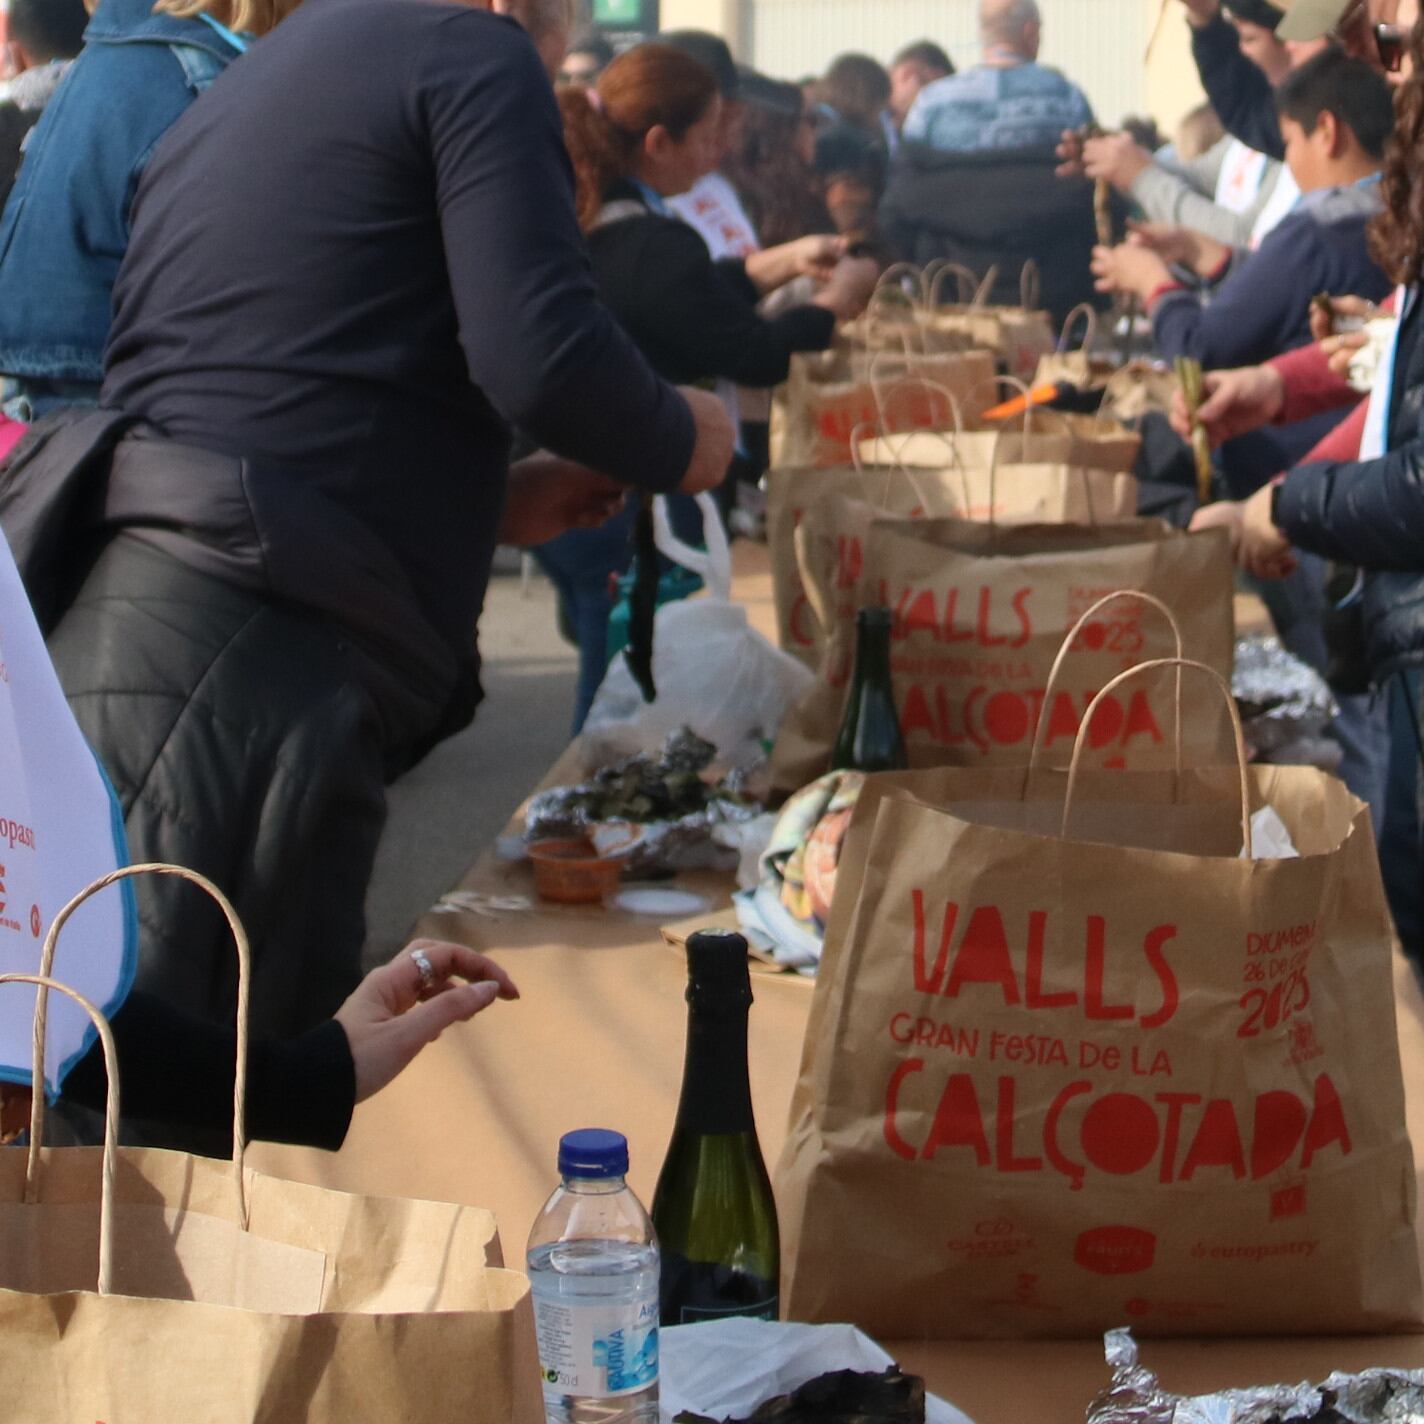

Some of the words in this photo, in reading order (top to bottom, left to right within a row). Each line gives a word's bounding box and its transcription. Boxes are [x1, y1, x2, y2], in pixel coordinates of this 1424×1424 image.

[901, 682, 1164, 758] ALÇOTADA
[912, 889, 1180, 1030] VALLS
[889, 1012, 980, 1058] GRAN
[1132, 1048, 1174, 1077] LA
[882, 1057, 1353, 1192] CALÇOTADA
